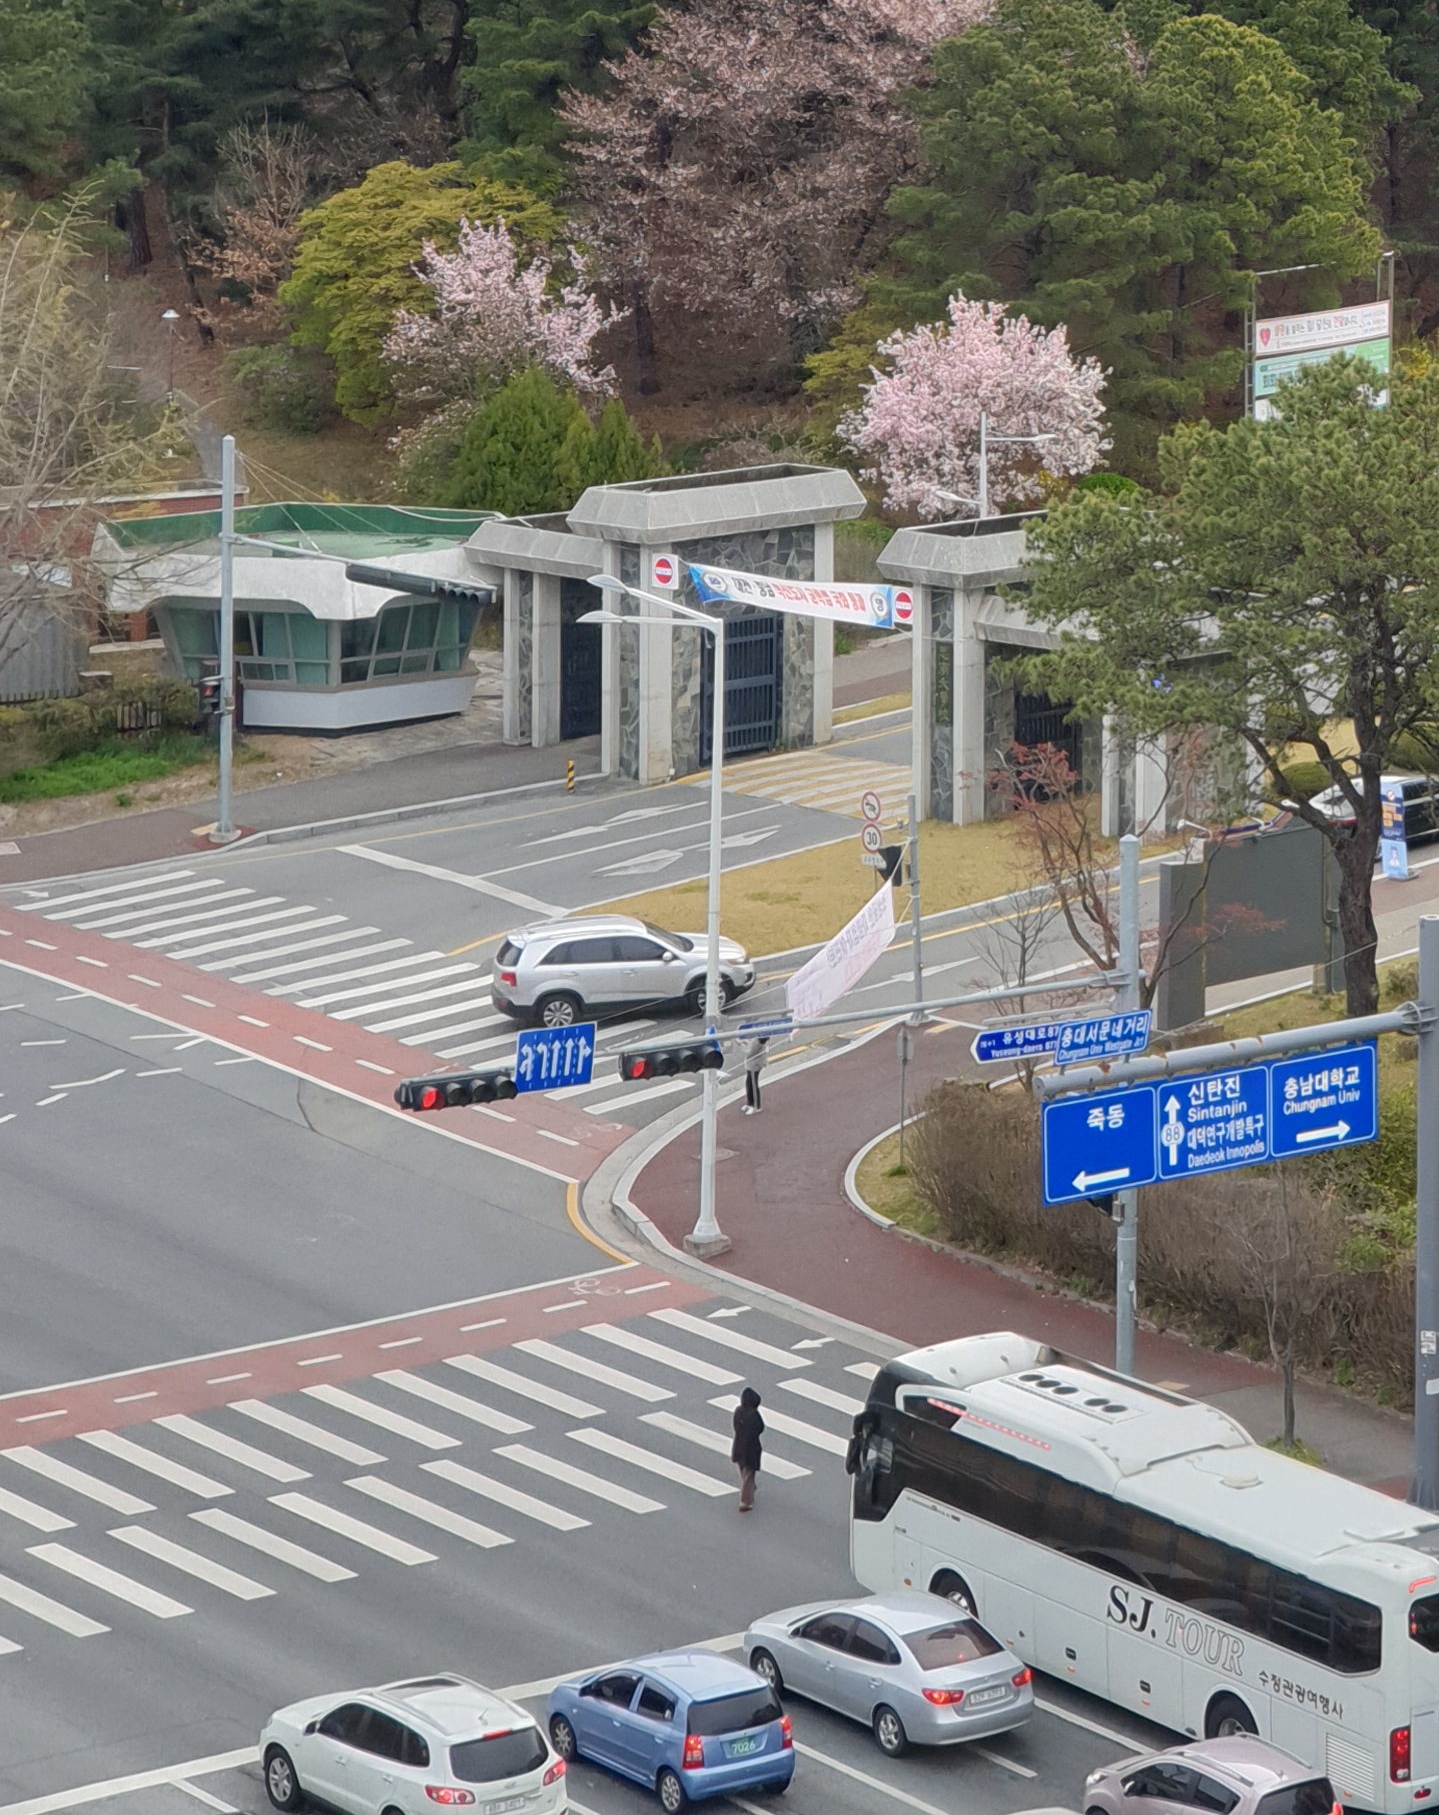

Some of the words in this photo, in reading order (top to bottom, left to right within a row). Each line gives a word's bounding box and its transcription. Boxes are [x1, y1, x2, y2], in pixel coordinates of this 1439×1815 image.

[866, 831, 878, 846] 30
[1002, 1026, 1060, 1045] 유성대로87
[1061, 1014, 1148, 1048] 충대서문네거리
[1188, 1075, 1240, 1105] 신탄진
[1284, 1066, 1361, 1099] 충남대학교
[1187, 1099, 1247, 1122] Sintanjin
[1283, 1094, 1337, 1115] Chungnam
[1338, 1088, 1361, 1104] Univ
[1086, 1103, 1125, 1131] 죽동
[1187, 1114, 1265, 1150] 대덕연구개발특구
[1188, 1147, 1226, 1168] Daedeok
[1226, 1139, 1265, 1160] Innopolis
[1165, 1607, 1246, 1677] TOUR
[1258, 1670, 1344, 1720] 수정관광여행사
[731, 1739, 756, 1754] 7026
